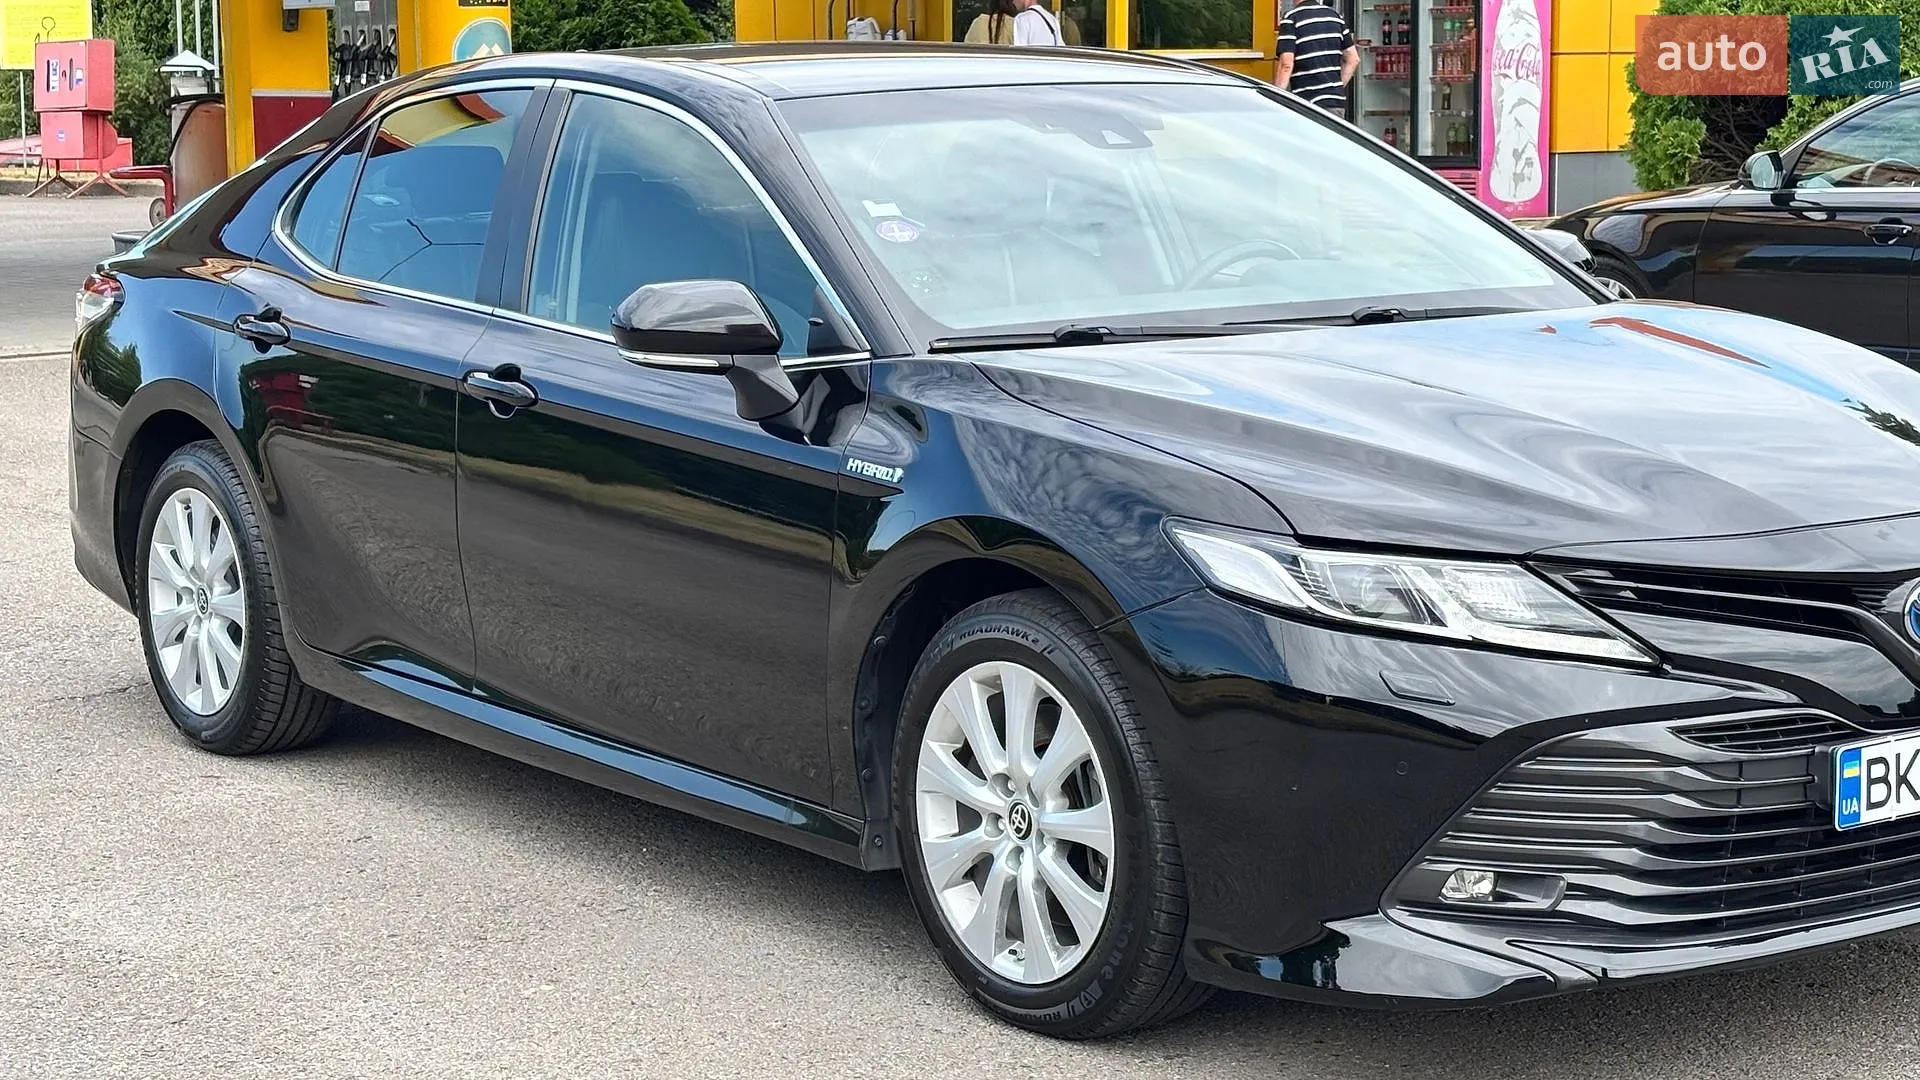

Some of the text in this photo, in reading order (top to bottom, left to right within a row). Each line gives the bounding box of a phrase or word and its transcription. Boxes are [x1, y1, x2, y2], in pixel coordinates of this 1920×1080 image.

[1492, 43, 1541, 80] oca-Cola
[846, 457, 894, 482] HYBRID
[1866, 749, 1920, 811] BK
[1842, 797, 1860, 816] UA
